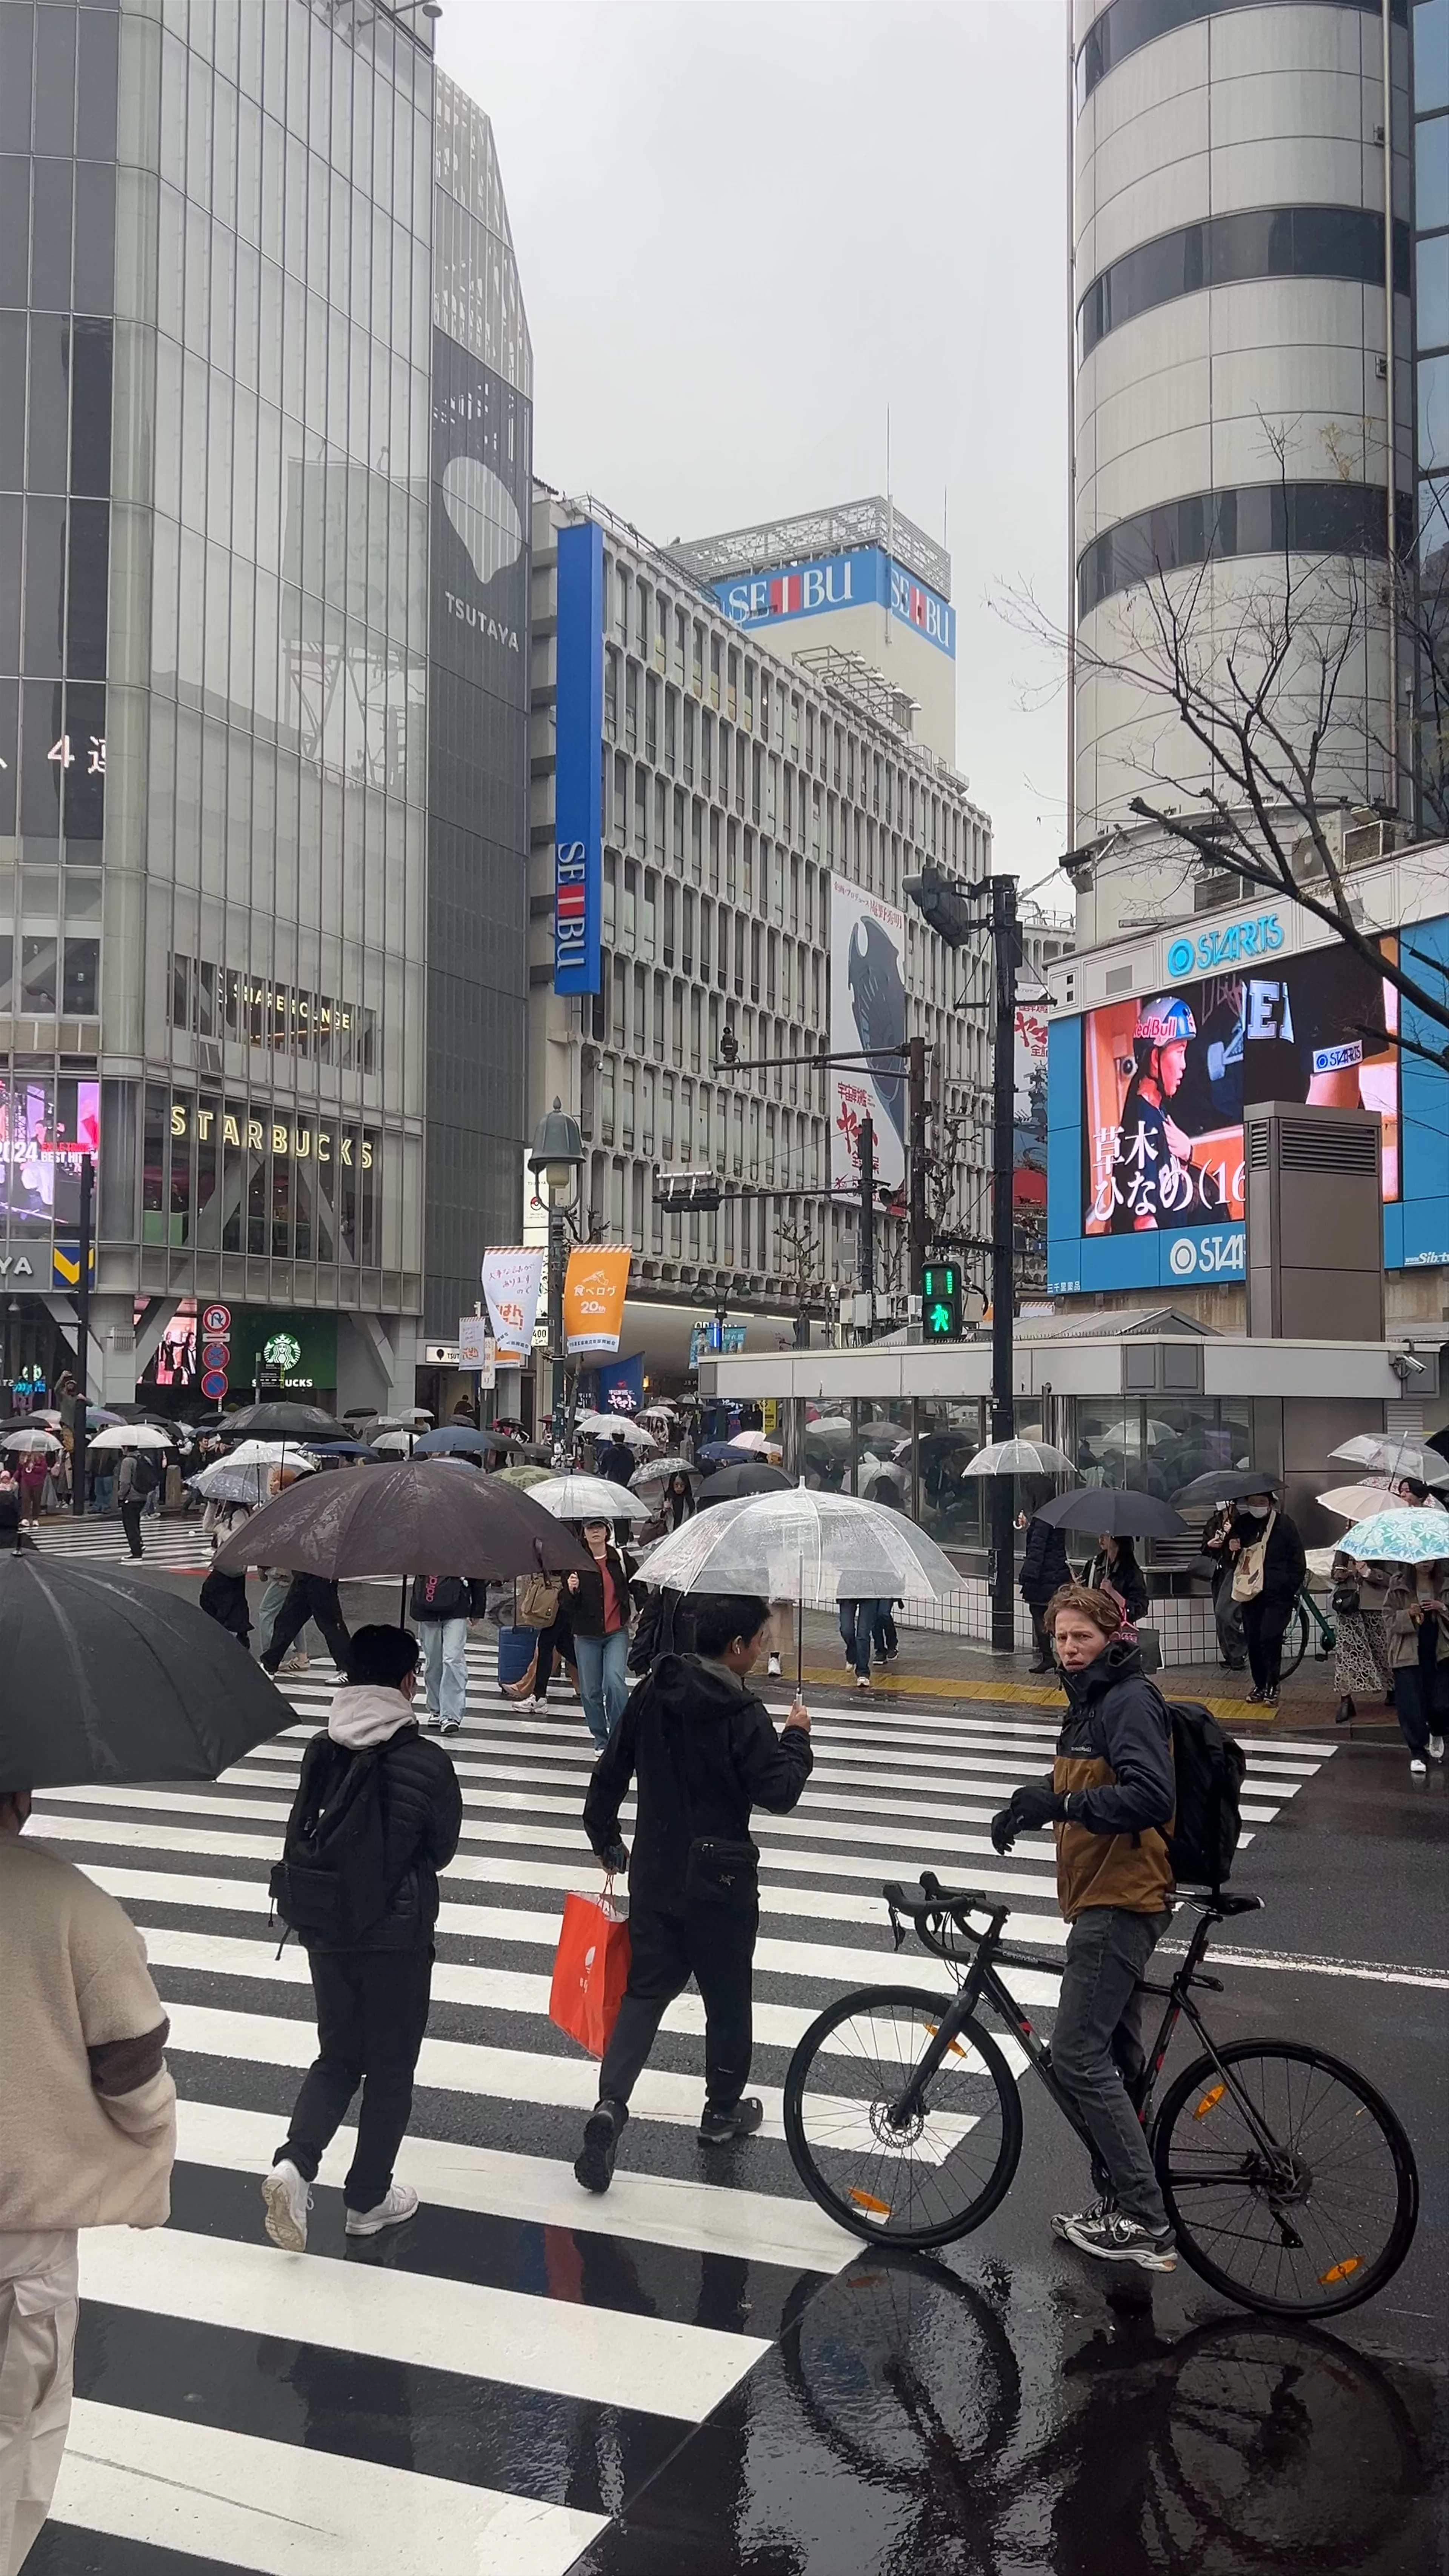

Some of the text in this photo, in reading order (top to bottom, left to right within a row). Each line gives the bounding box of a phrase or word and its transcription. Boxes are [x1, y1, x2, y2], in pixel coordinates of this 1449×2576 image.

[729, 561, 853, 623] SEIBU
[891, 568, 950, 649] SEIBU
[445, 591, 520, 652] TSUTAYA
[557, 841, 585, 969] SEIBU
[1197, 913, 1284, 969] STARTS
[1151, 1017, 1177, 1037] Bull
[1330, 1046, 1361, 1066] STARTS
[41, 1151, 67, 1163] BEST
[171, 1106, 373, 1168] STARBUCKS
[1093, 1121, 1158, 1174] 草木
[574, 1284, 617, 1296] 食べログ
[581, 1301, 606, 1313] 20th
